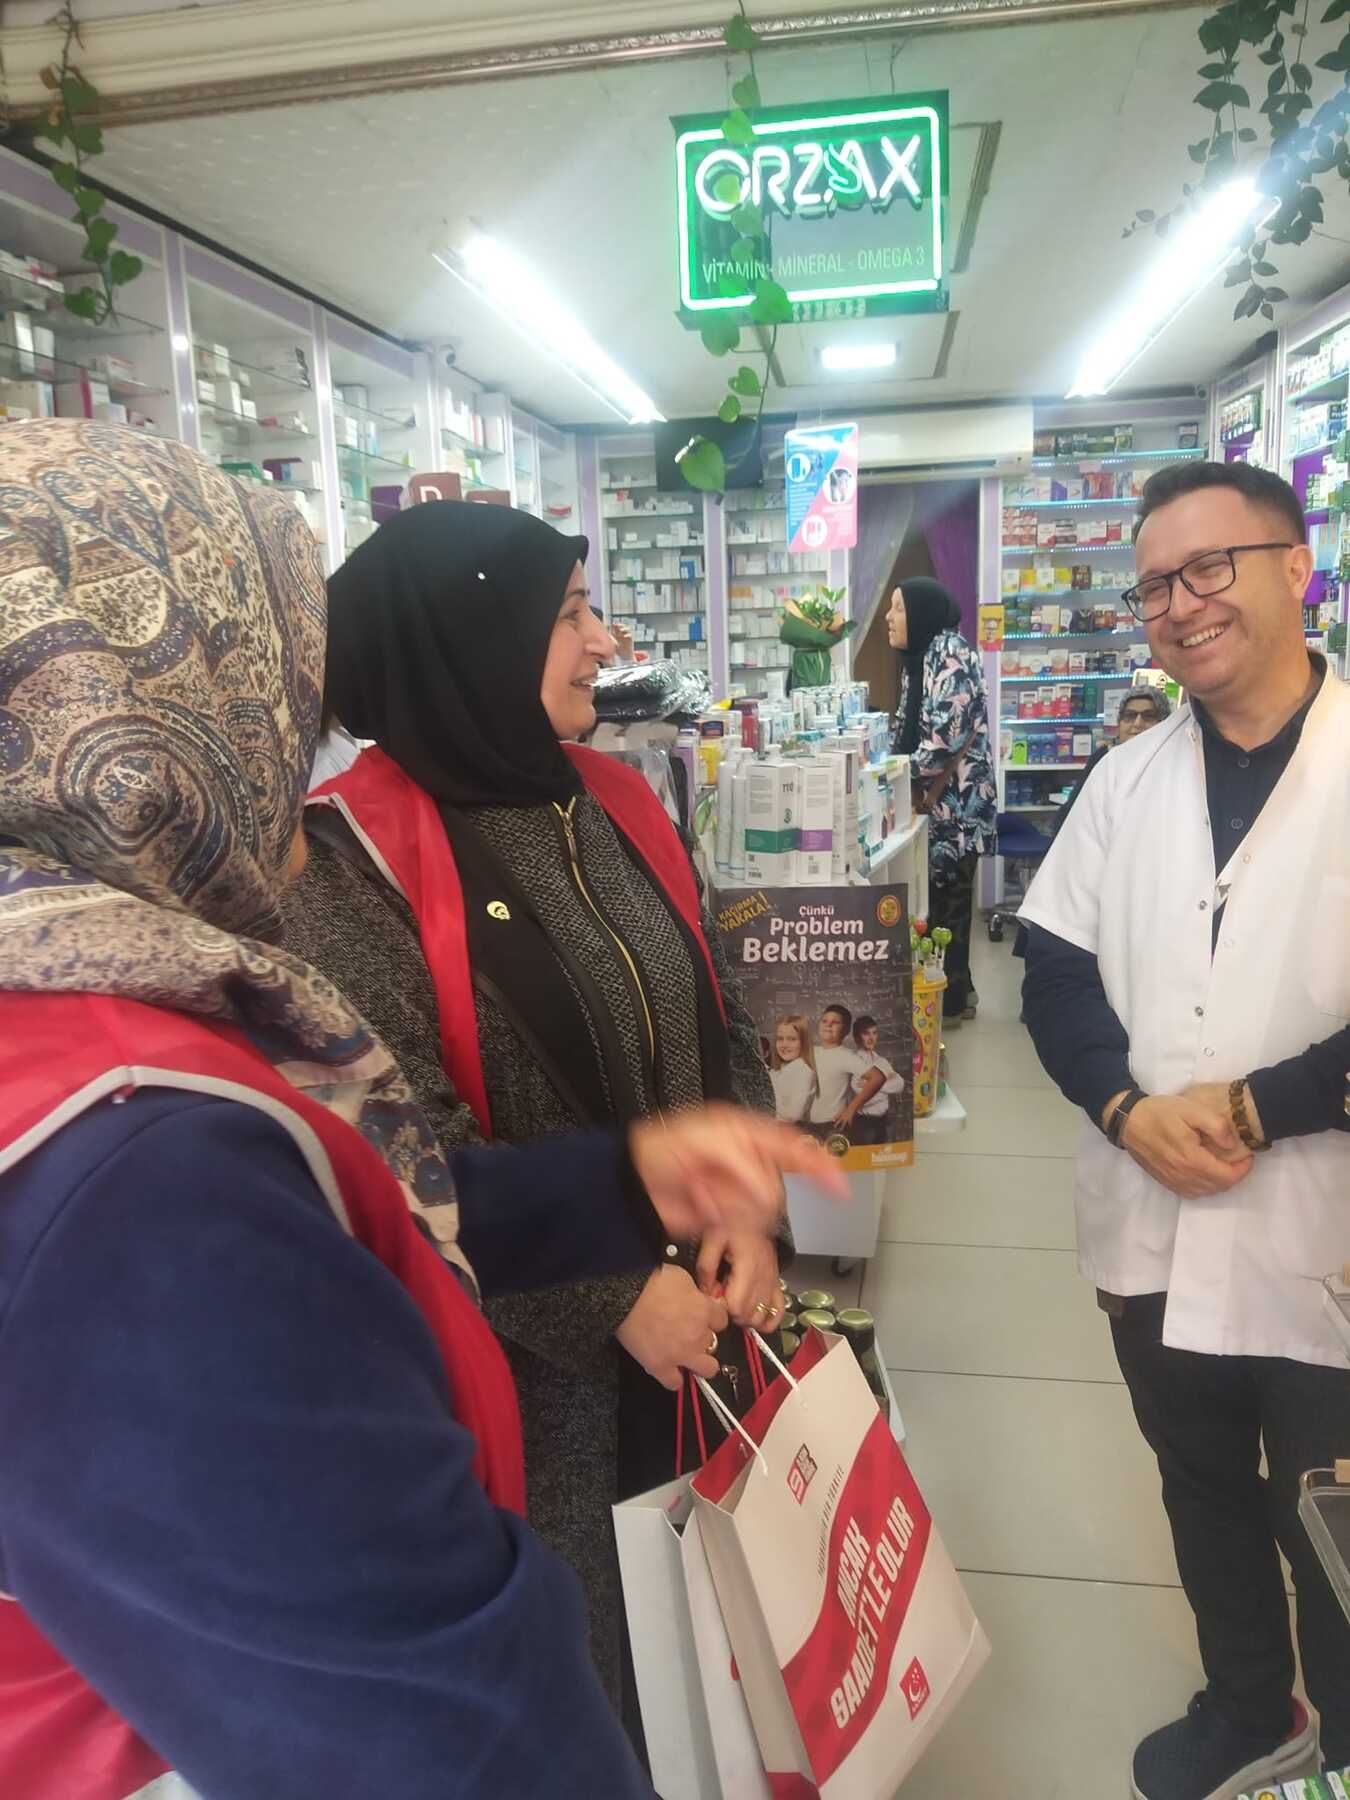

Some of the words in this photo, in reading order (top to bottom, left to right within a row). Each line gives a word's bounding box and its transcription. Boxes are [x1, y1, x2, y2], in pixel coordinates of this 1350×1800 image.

[695, 134, 921, 212] ORZAX
[857, 247, 912, 271] OMEGA
[914, 245, 925, 265] 3
[799, 905, 835, 918] Çünkü
[770, 917, 864, 936] Problem
[742, 936, 889, 963] Beklemez
[876, 1496, 915, 1583] OLUR
[837, 1516, 871, 1628] ANCAK
